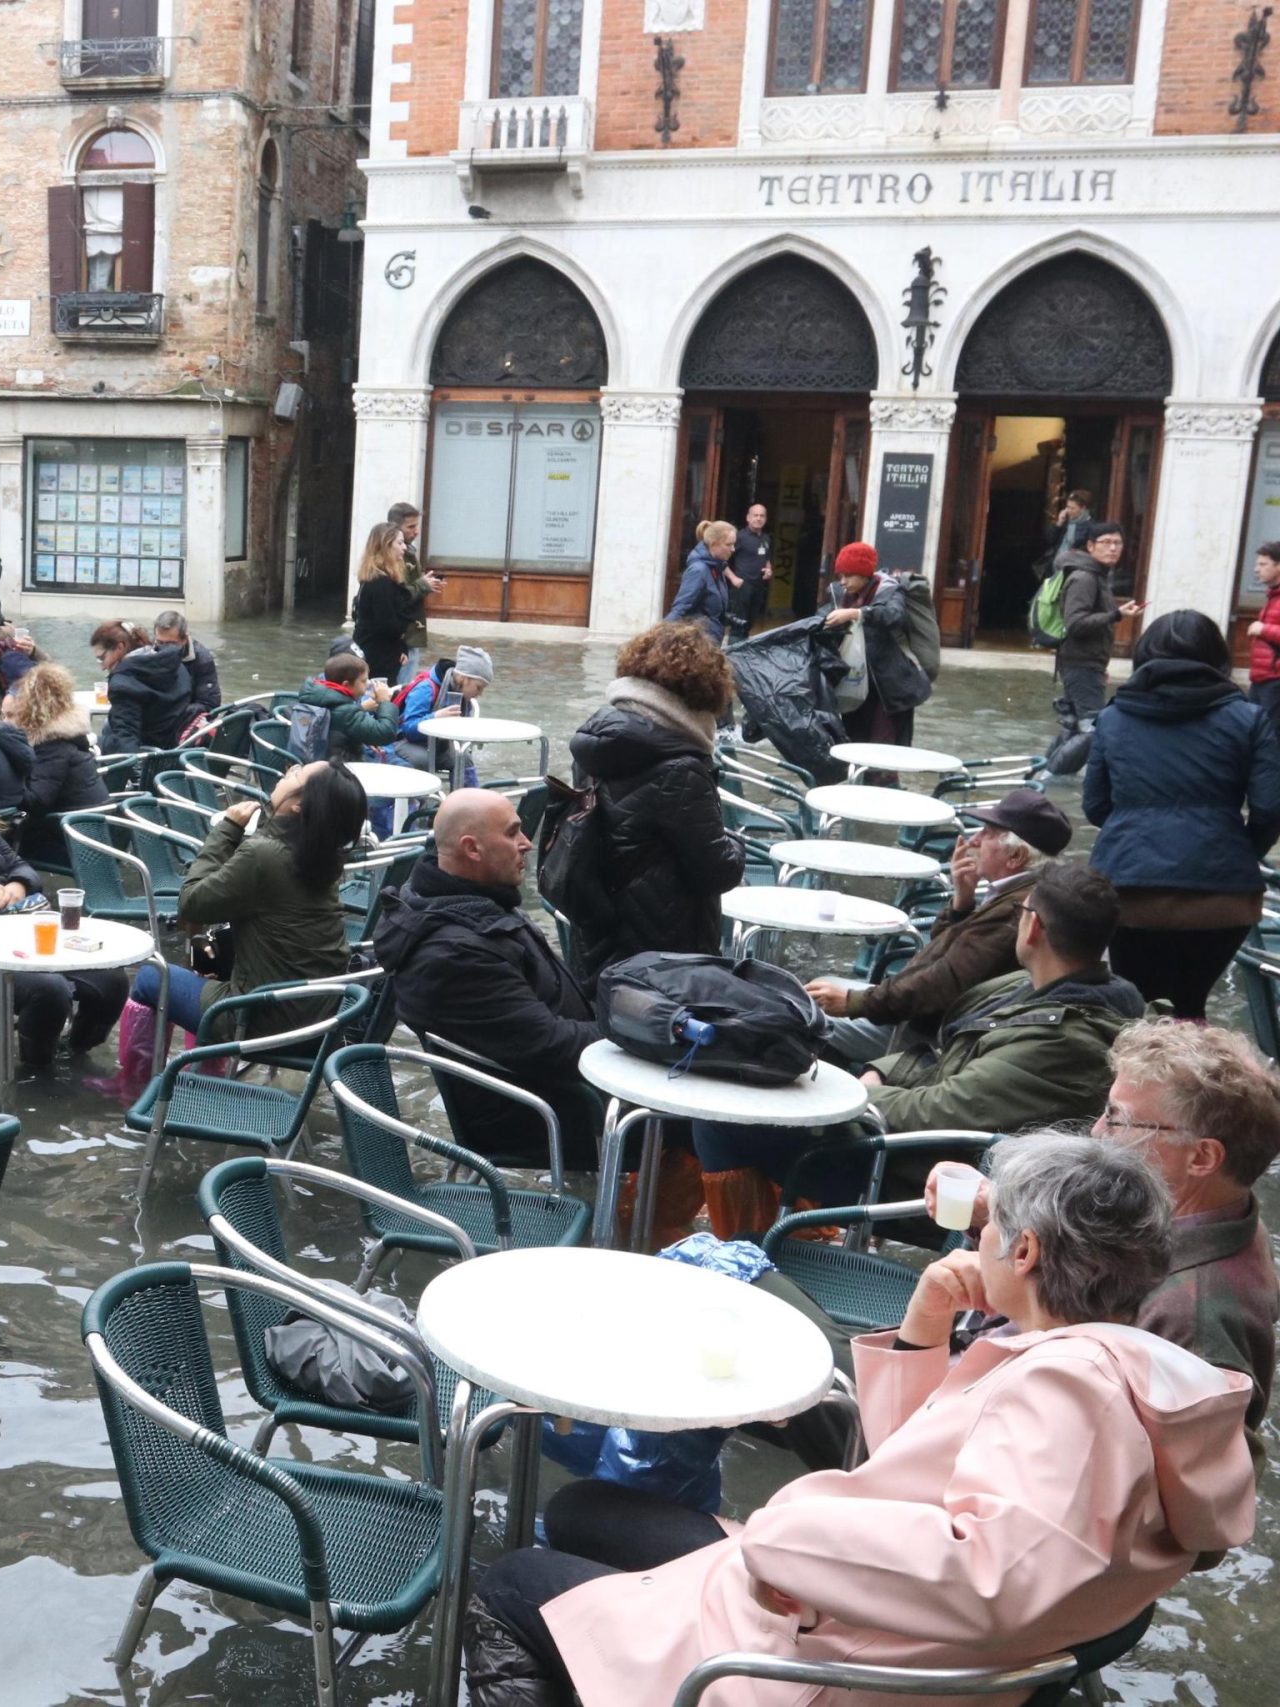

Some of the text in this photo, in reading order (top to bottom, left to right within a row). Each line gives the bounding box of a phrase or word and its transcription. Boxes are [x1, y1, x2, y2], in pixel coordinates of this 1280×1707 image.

[758, 169, 1117, 206] TEATRO ITALIA
[445, 421, 565, 437] DESPAR
[886, 463, 929, 473] TEATRO
[885, 473, 928, 483] ITALIA
[890, 513, 916, 521] APERTO
[774, 484, 801, 585] HILARY
